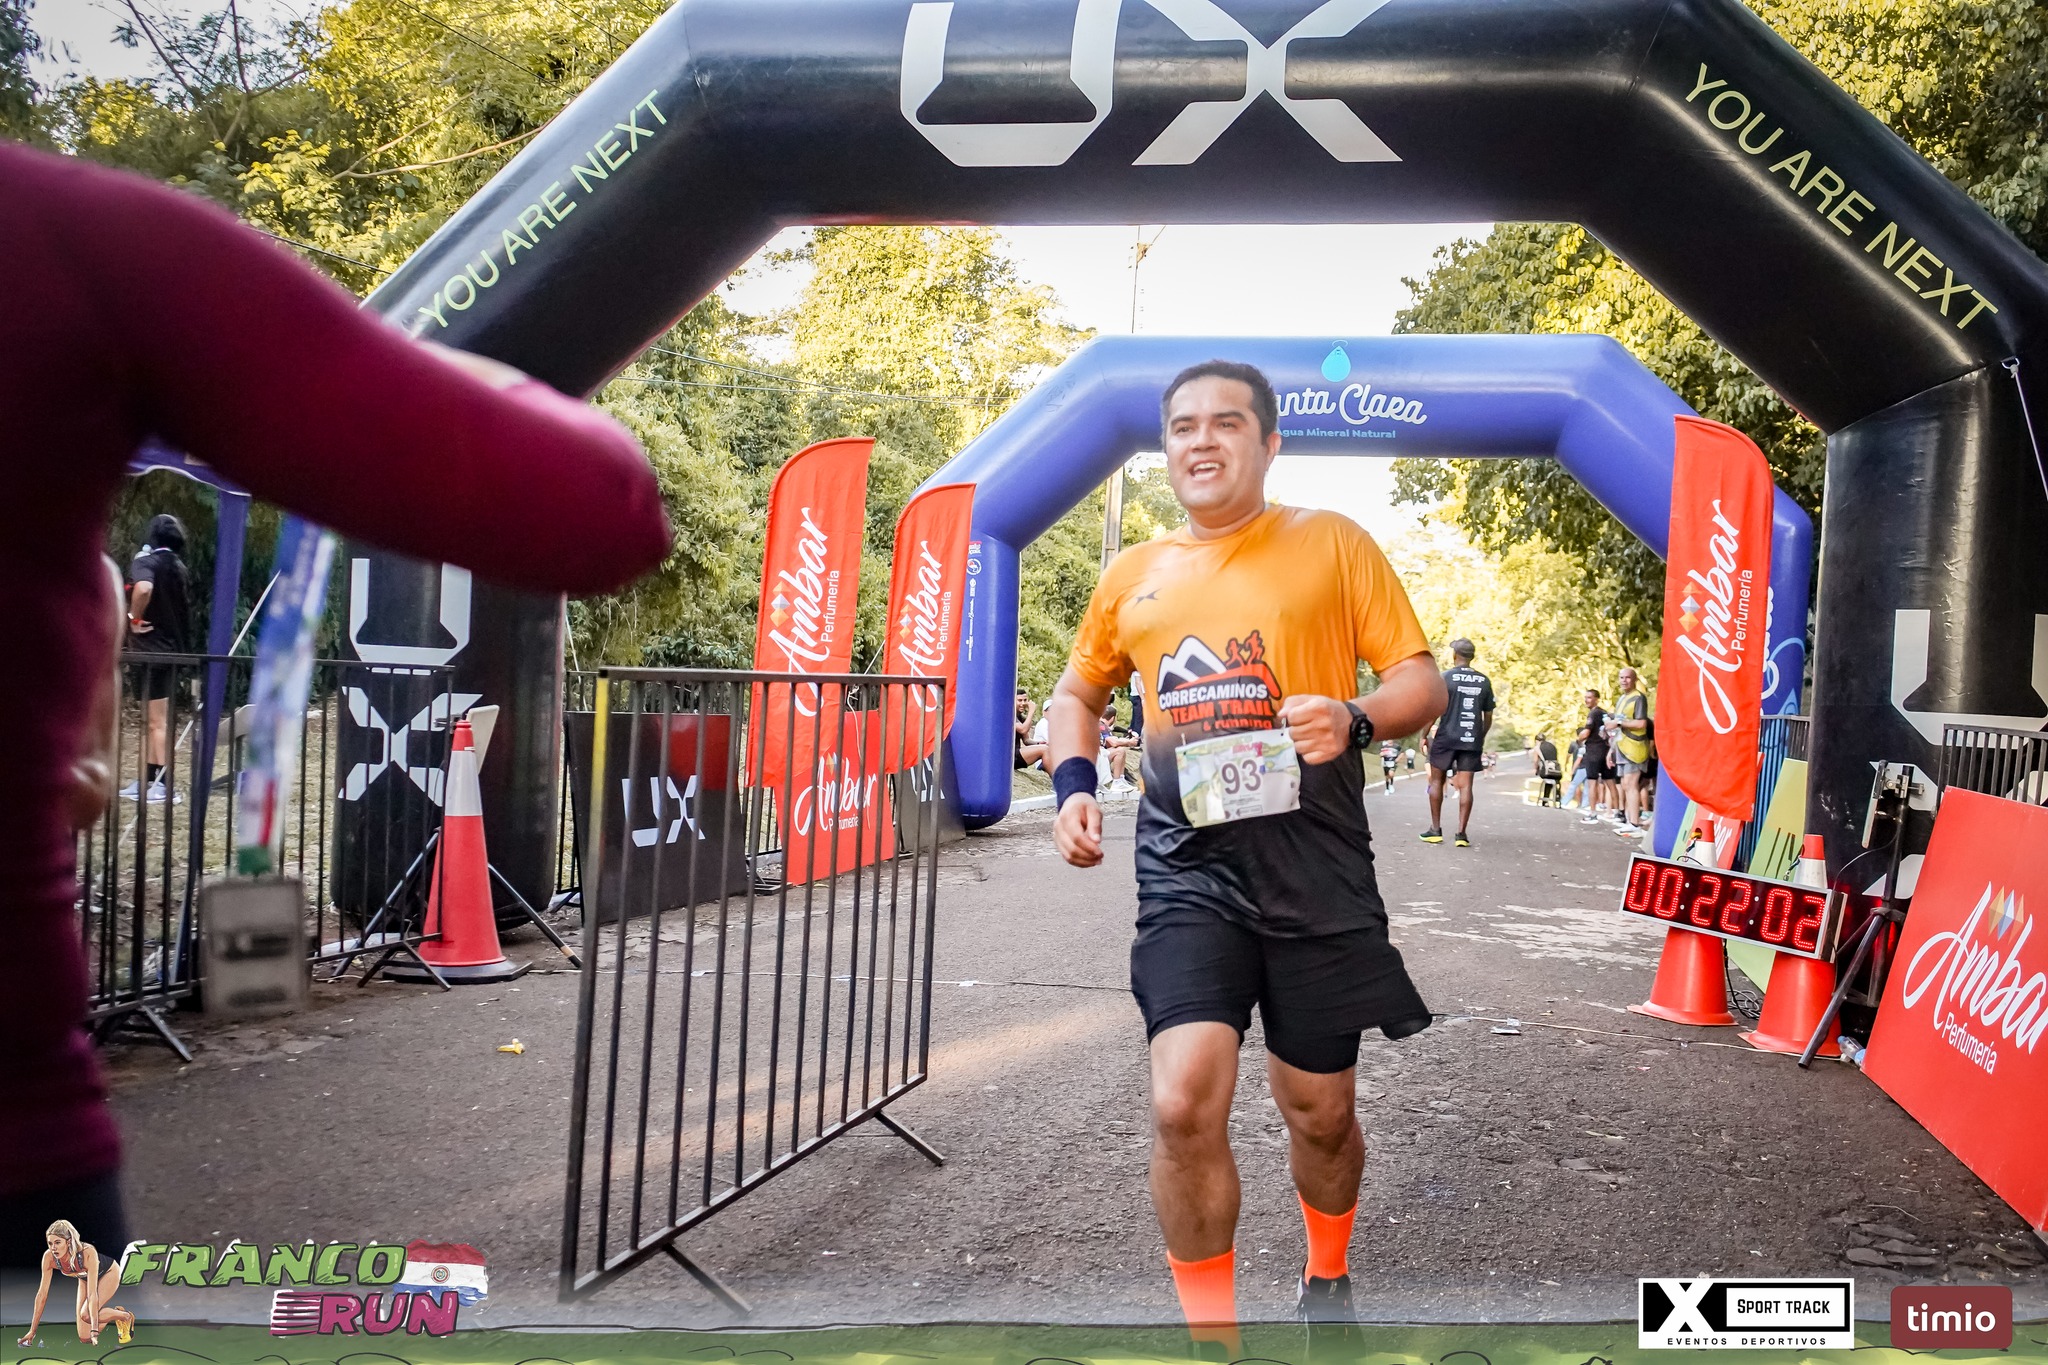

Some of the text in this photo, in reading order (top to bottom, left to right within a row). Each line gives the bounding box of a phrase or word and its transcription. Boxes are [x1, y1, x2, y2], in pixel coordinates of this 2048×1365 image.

[901, 0, 1403, 167] UX
[418, 88, 667, 328] YOU ARE NEXT
[1686, 62, 1998, 329] YOU ARE NEXT
[1276, 387, 1336, 417] anta
[1306, 427, 1349, 438] Mineral
[1352, 429, 1396, 439] Natural
[768, 506, 829, 717] Ambar
[820, 570, 840, 643] Perfumería
[898, 540, 943, 713] Ambar
[936, 591, 952, 650] Perfumería
[1675, 499, 1740, 735] Ambar
[1731, 569, 1753, 652] Perfumería
[1159, 684, 1269, 710] CORRECAMINOS
[1171, 699, 1274, 725] TEAM TRAIL
[1452, 673, 1486, 683] STAFF
[1221, 759, 1262, 795] 93
[1627, 862, 1826, 950] 00:22:02
[1941, 1011, 1997, 1075] Perfumería
